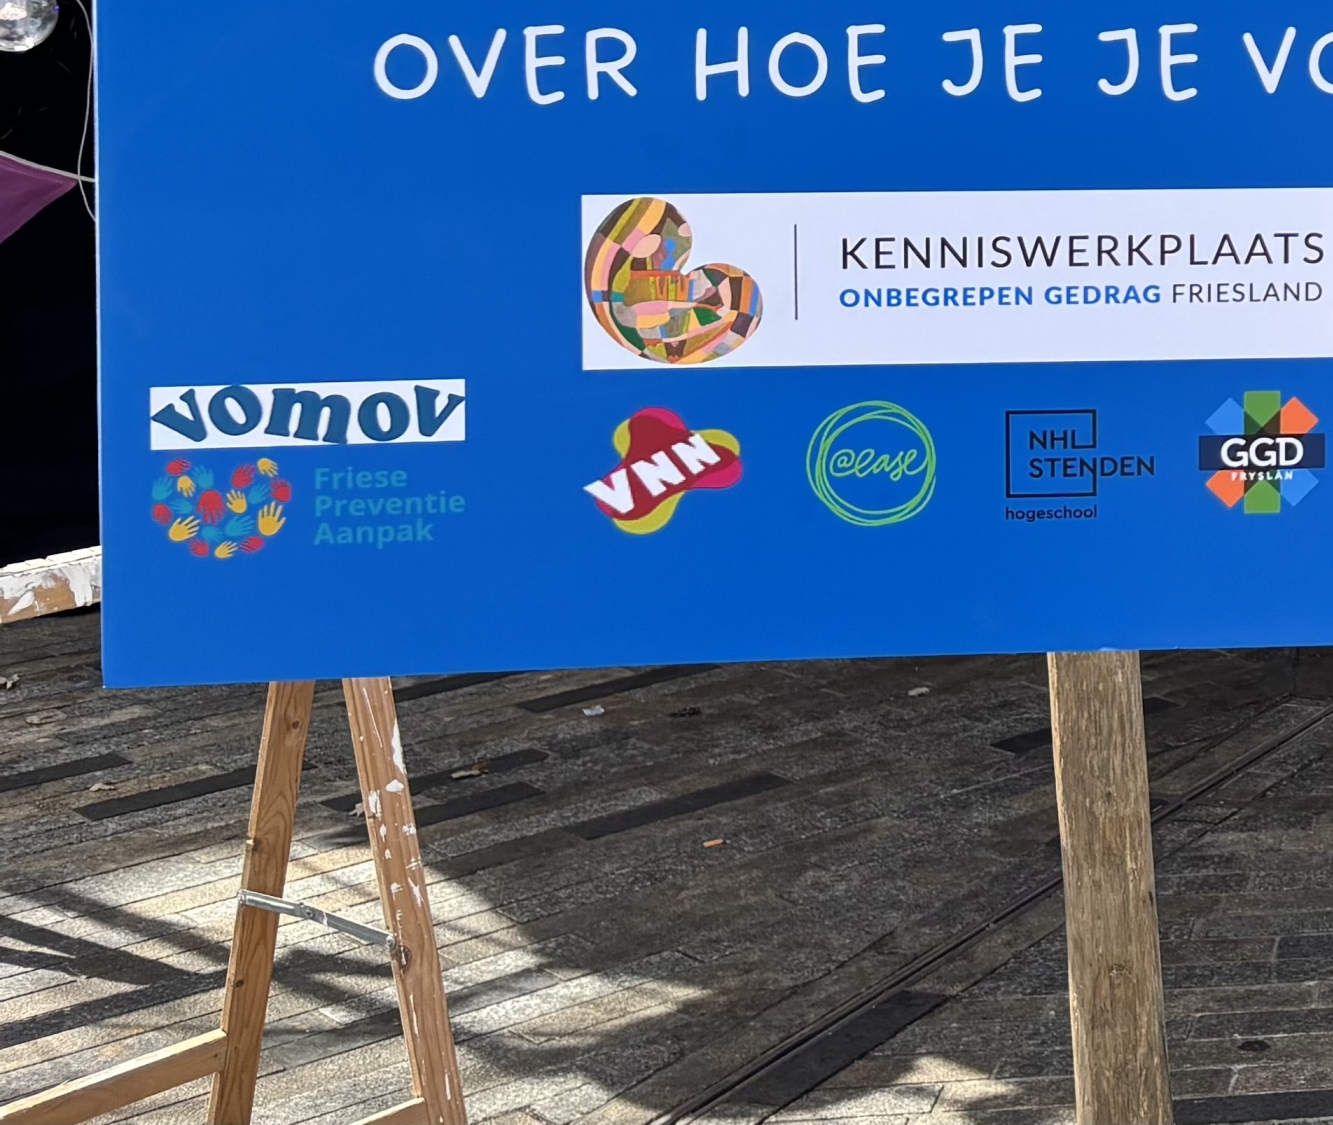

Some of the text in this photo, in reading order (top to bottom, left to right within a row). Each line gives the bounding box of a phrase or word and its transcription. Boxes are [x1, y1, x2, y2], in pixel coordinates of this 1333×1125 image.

[373, 23, 639, 106] OVER
[693, 23, 887, 105] HOE
[941, 23, 1044, 102] JE
[1097, 23, 1199, 102] JE
[840, 231, 1326, 271] KENNISWERKPLAATS
[838, 281, 1324, 308] ONBEGREPEN GEDRAG FRIESLAND
[1029, 428, 1096, 451] NHL
[1220, 436, 1304, 468] GGD
[314, 467, 408, 490] Friese
[584, 432, 722, 516] VNN
[829, 447, 929, 482] @ease
[1029, 455, 1155, 479] STENDEN
[314, 491, 466, 517] Preventie
[1005, 504, 1098, 523] hogeschool
[314, 519, 434, 550] Aanpak
